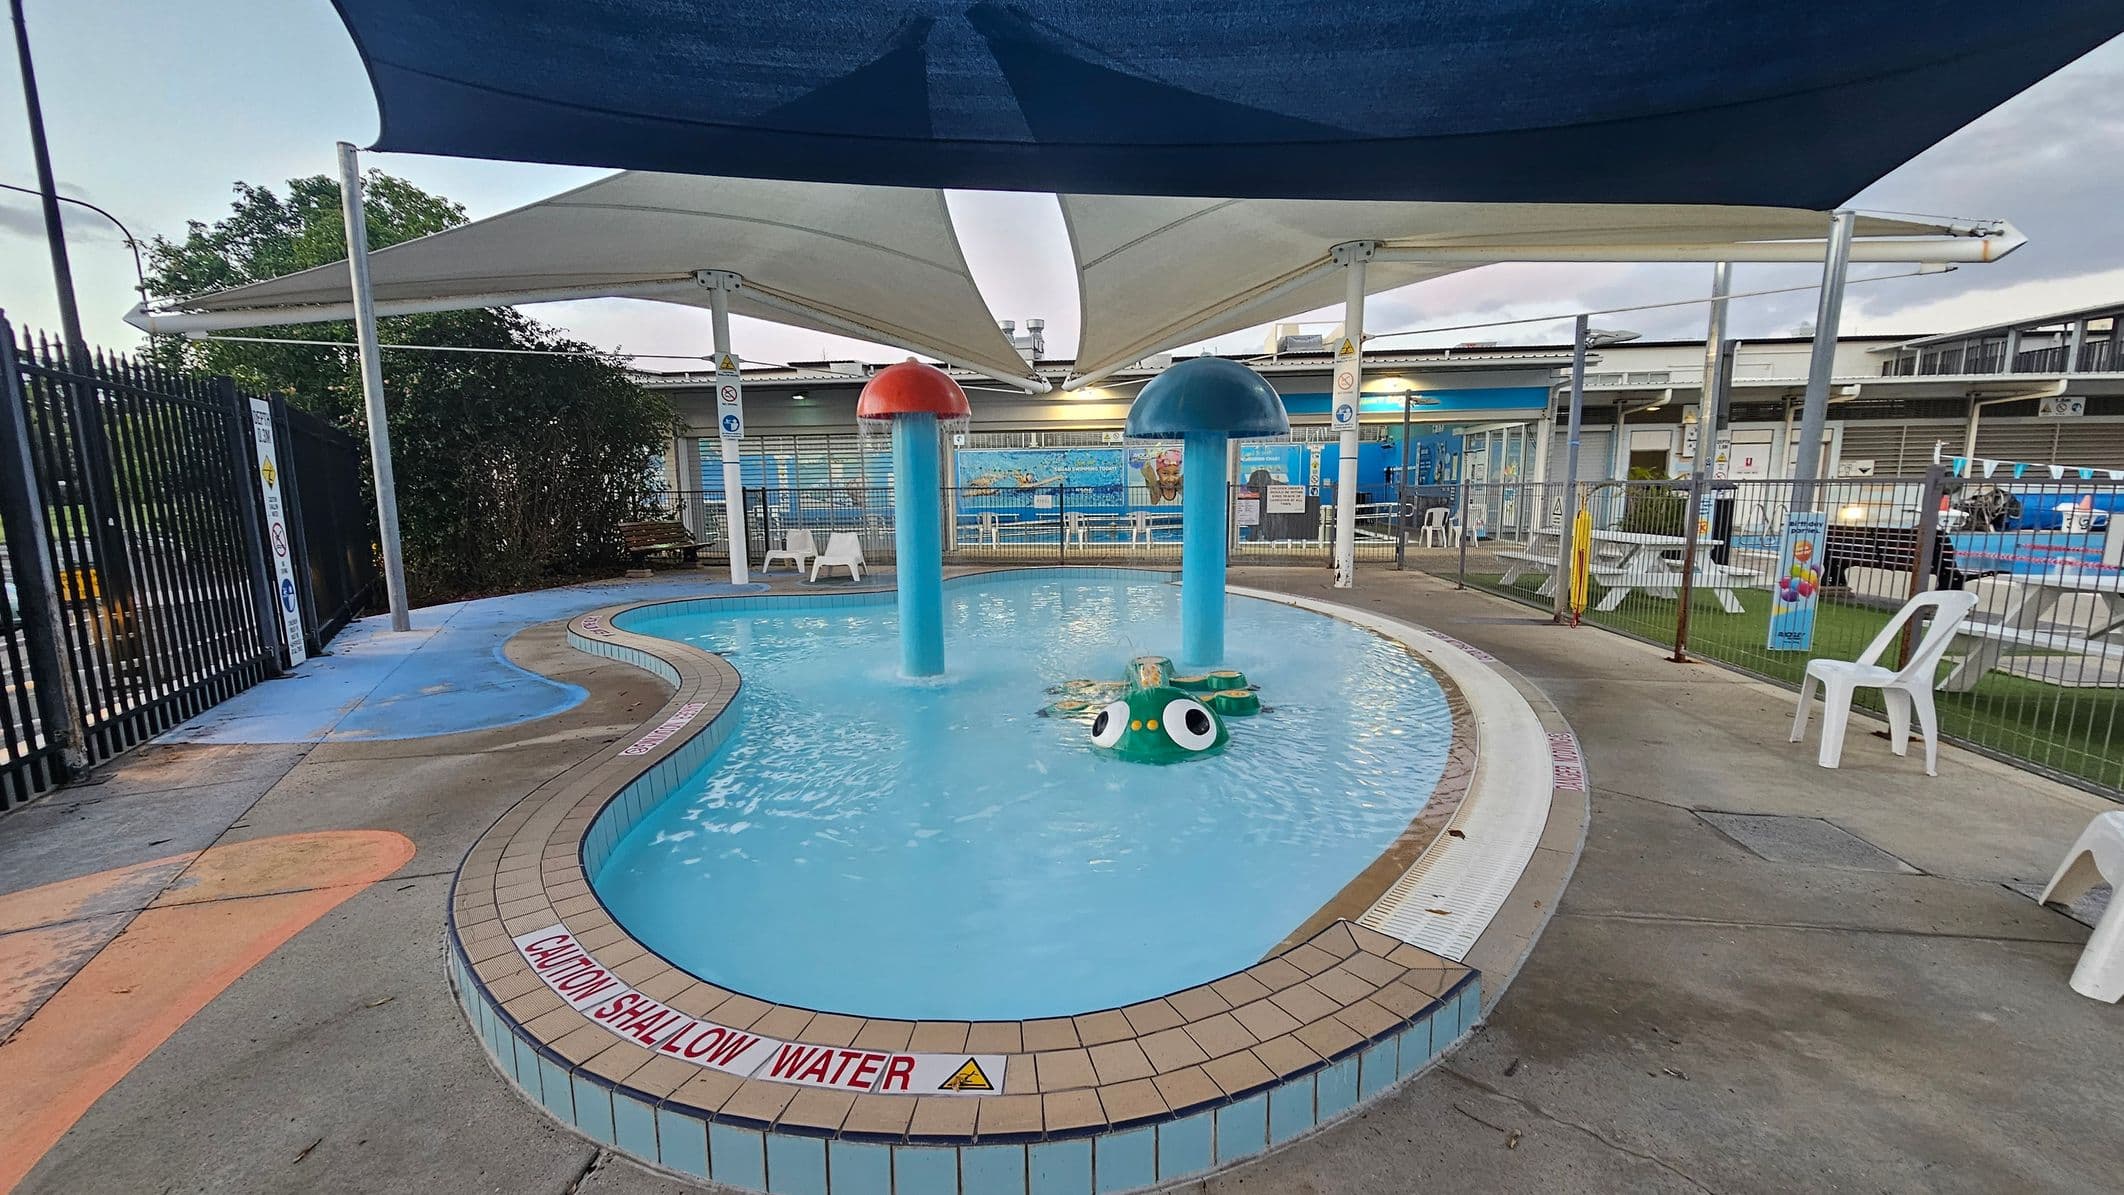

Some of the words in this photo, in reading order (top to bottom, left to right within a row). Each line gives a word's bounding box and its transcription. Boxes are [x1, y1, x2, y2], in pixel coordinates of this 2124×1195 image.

[524, 934, 618, 1002] CAUTION
[594, 993, 761, 1067] SHALLOW
[770, 1043, 916, 1092] WATER
